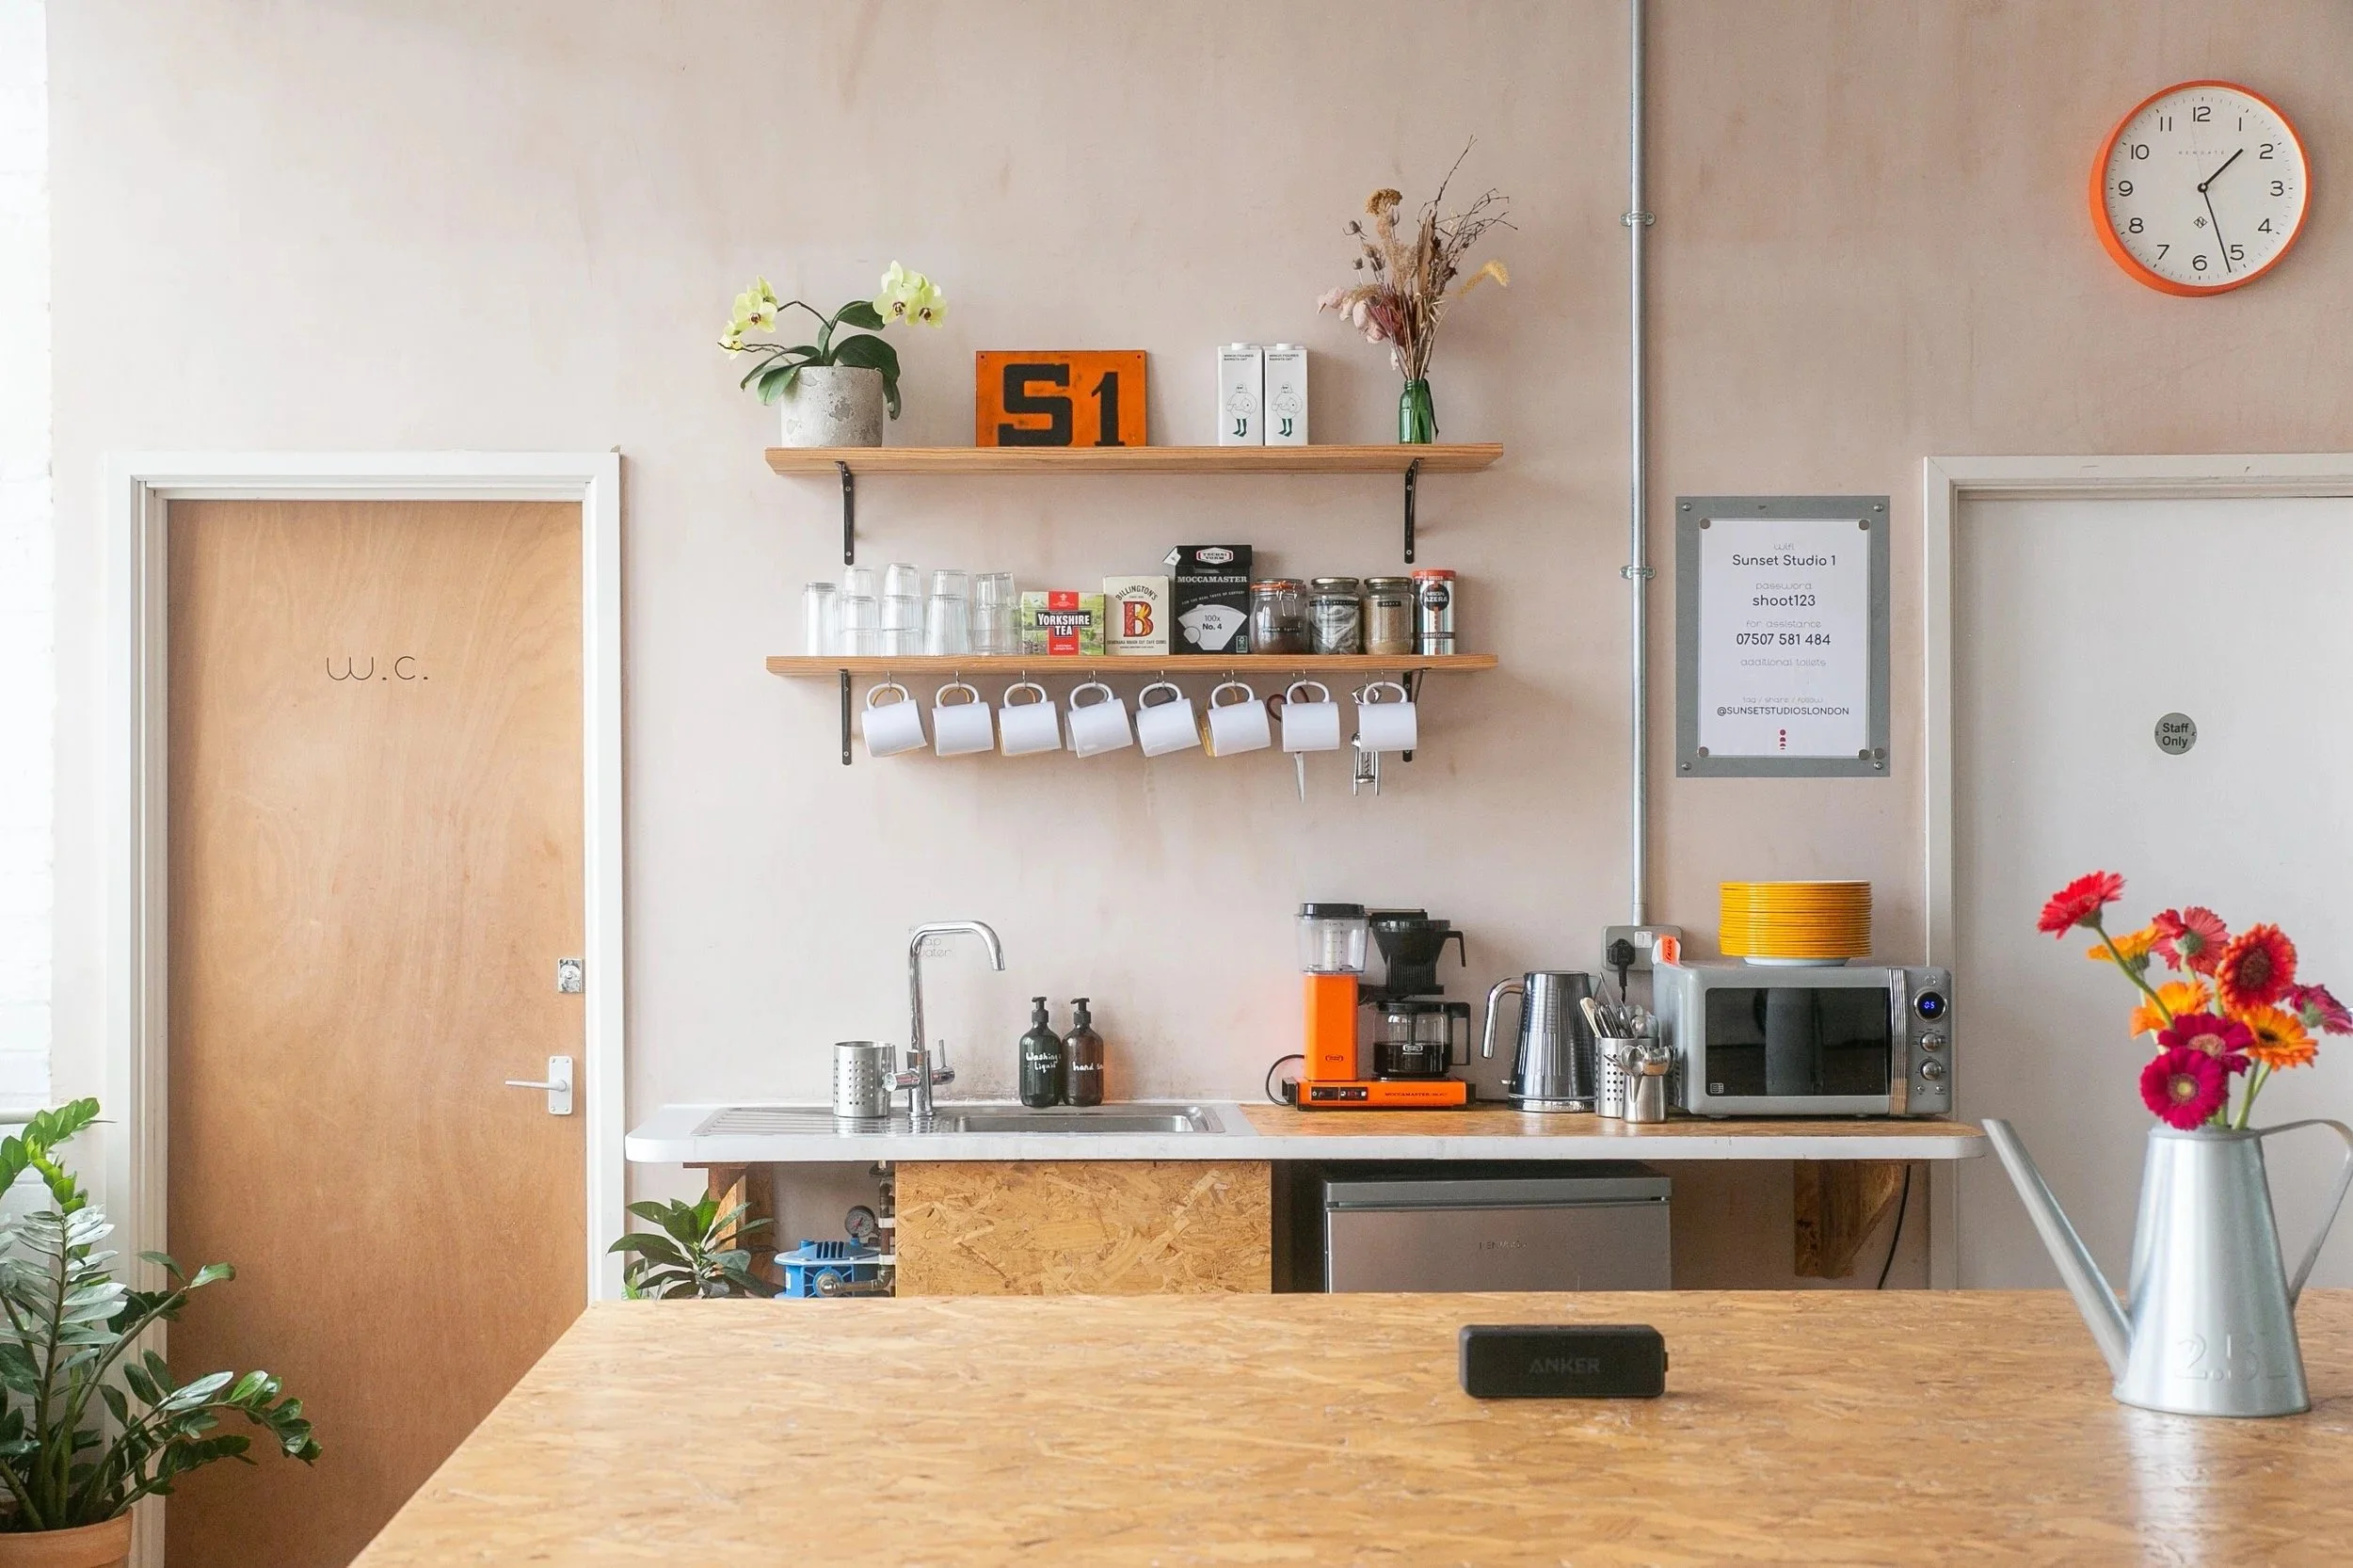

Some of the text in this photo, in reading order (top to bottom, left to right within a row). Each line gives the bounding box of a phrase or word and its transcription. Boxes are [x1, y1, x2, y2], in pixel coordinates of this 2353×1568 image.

[2192, 106, 2211, 122] 12
[2159, 116, 2172, 132] 11
[2130, 144, 2150, 160] 10
[2259, 143, 2273, 160] 2
[2118, 181, 2134, 197] 9
[2269, 181, 2284, 197] 3
[2128, 217, 2144, 233] 8
[2257, 218, 2272, 234] 4
[2156, 244, 2169, 260] 7
[2230, 244, 2245, 261] 5
[2192, 255, 2207, 271] 6
[998, 363, 1126, 447] S1
[1773, 542, 1795, 551] wifi
[1732, 553, 1836, 566] Sunset Studio 1
[1176, 575, 1247, 584] MOCCAMASTER
[1755, 582, 1813, 591] password
[1115, 584, 1159, 601] BILLINGTON'S
[1752, 594, 1816, 606] shoot123
[1037, 613, 1090, 626] YORKSHIRE
[1123, 600, 1154, 637] B
[1746, 619, 1822, 628] for assistance
[1054, 625, 1073, 636] TEA
[1736, 632, 1831, 646] 07507 581 484
[1739, 658, 1826, 666] additional toilets
[1717, 706, 1849, 716] @SUNSETSTUDIOSLONDON
[2162, 722, 2189, 733] Staff
[2162, 735, 2188, 749] Only
[1072, 1061, 1094, 1071] hand
[1529, 1357, 1600, 1374] ANKER
